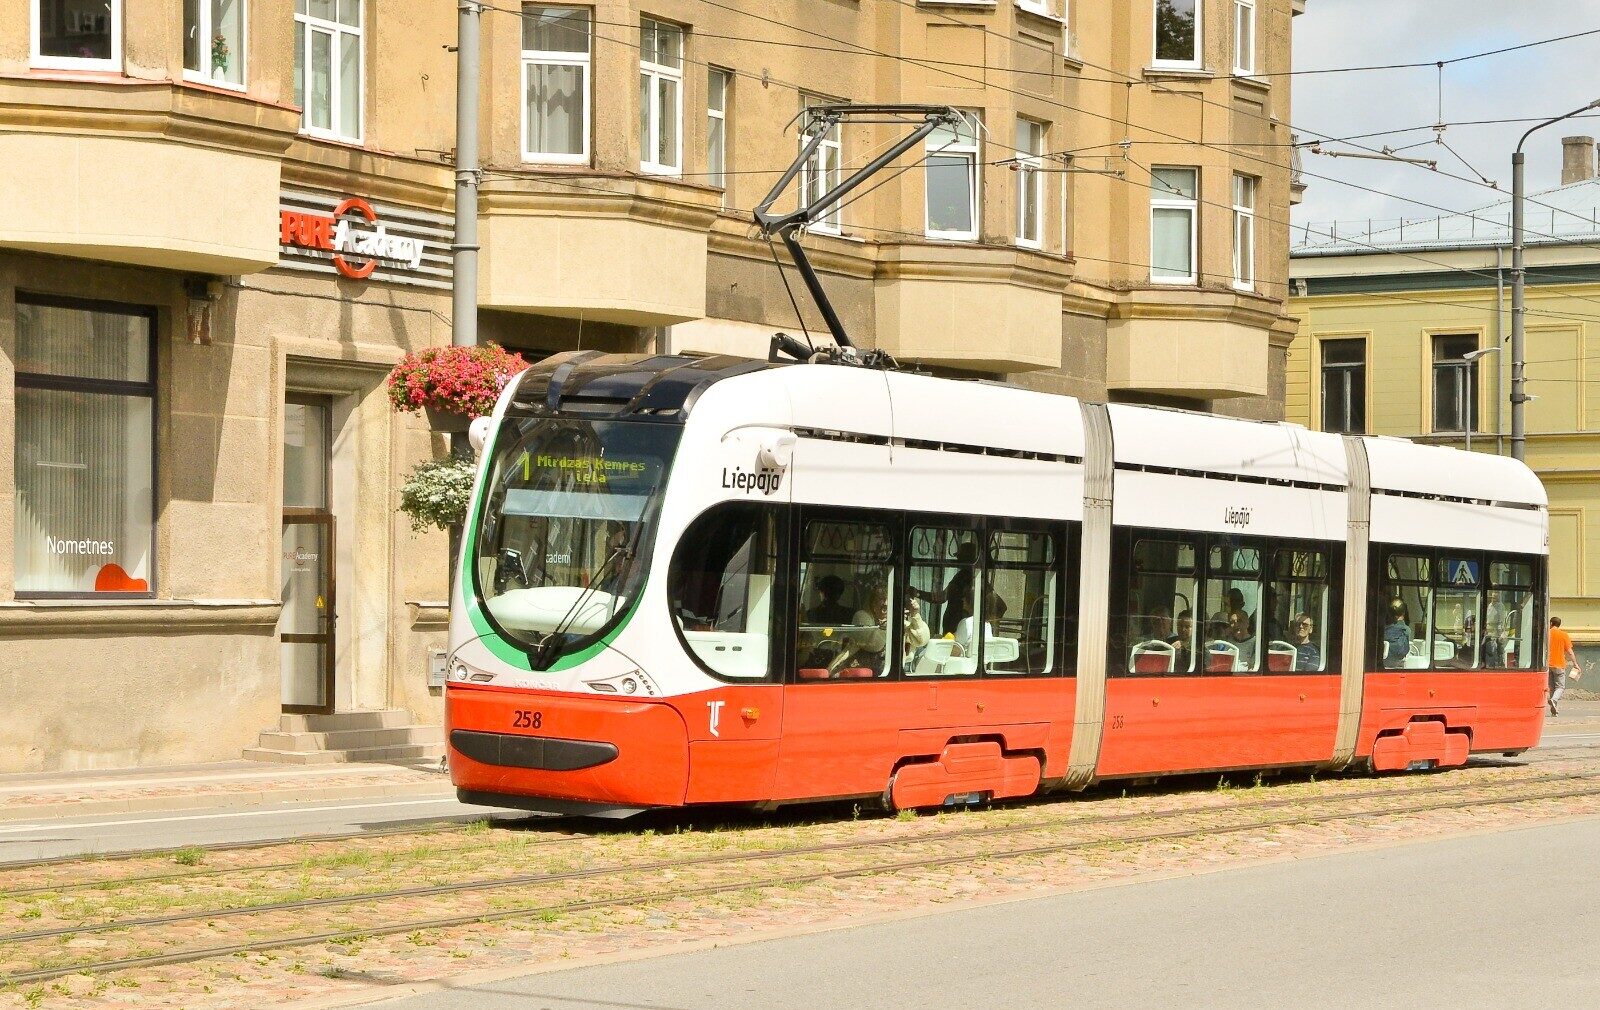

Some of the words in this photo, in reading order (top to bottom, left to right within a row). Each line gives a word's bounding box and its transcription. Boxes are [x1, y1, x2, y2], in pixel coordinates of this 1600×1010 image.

[537, 455, 591, 469] Mirdzas
[46, 535, 114, 555] Nometnes
[512, 710, 542, 729] 258
